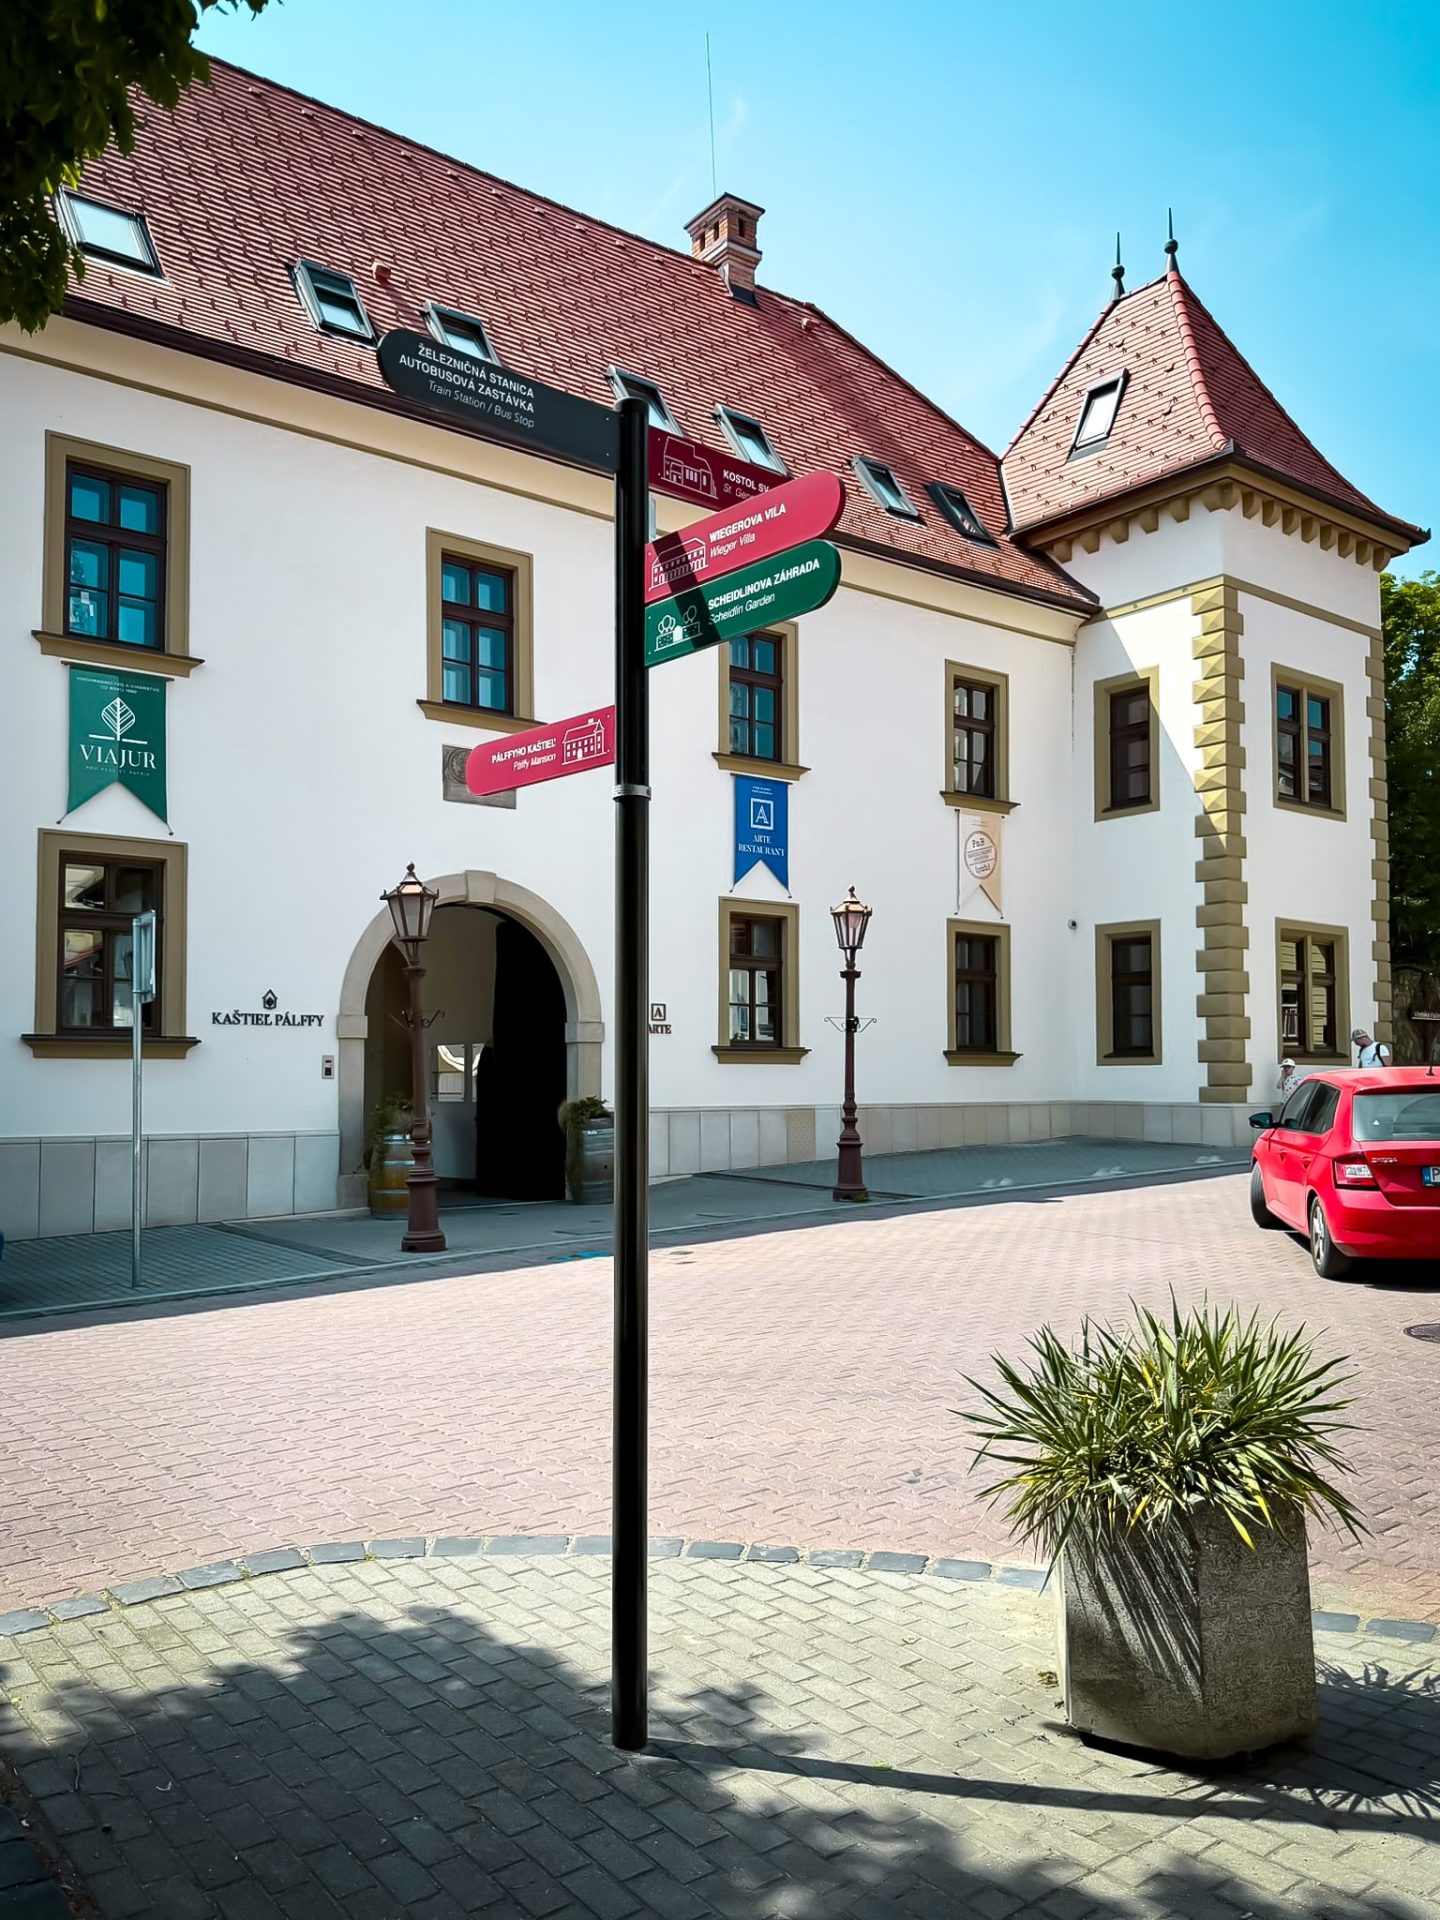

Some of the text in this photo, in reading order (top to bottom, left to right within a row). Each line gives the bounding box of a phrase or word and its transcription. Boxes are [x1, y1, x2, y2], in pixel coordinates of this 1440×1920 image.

[418, 342, 534, 398] ŽELEZNIČNÁ STANICA
[399, 354, 534, 413] AUTOBUSOVÁ ZASTÁVKA
[429, 379, 451, 397] Train
[453, 390, 486, 410] Station
[494, 404, 512, 420] Bus
[513, 412, 535, 428] Stop
[723, 469, 757, 490] KOSTOL
[709, 503, 787, 543] WIEGEROVA VILA
[710, 532, 756, 558] Wieger Villa
[708, 558, 820, 610] SCHEIDLINOVA ZÁHRADA
[708, 593, 776, 625] Scheidlin Garden
[80, 743, 157, 769] VIAJUR
[491, 746, 527, 764] PÁLFFYHO
[738, 843, 785, 857] RESTAURANT
[753, 834, 772, 845] ARTE
[274, 1011, 325, 1027] PÁLFFY
